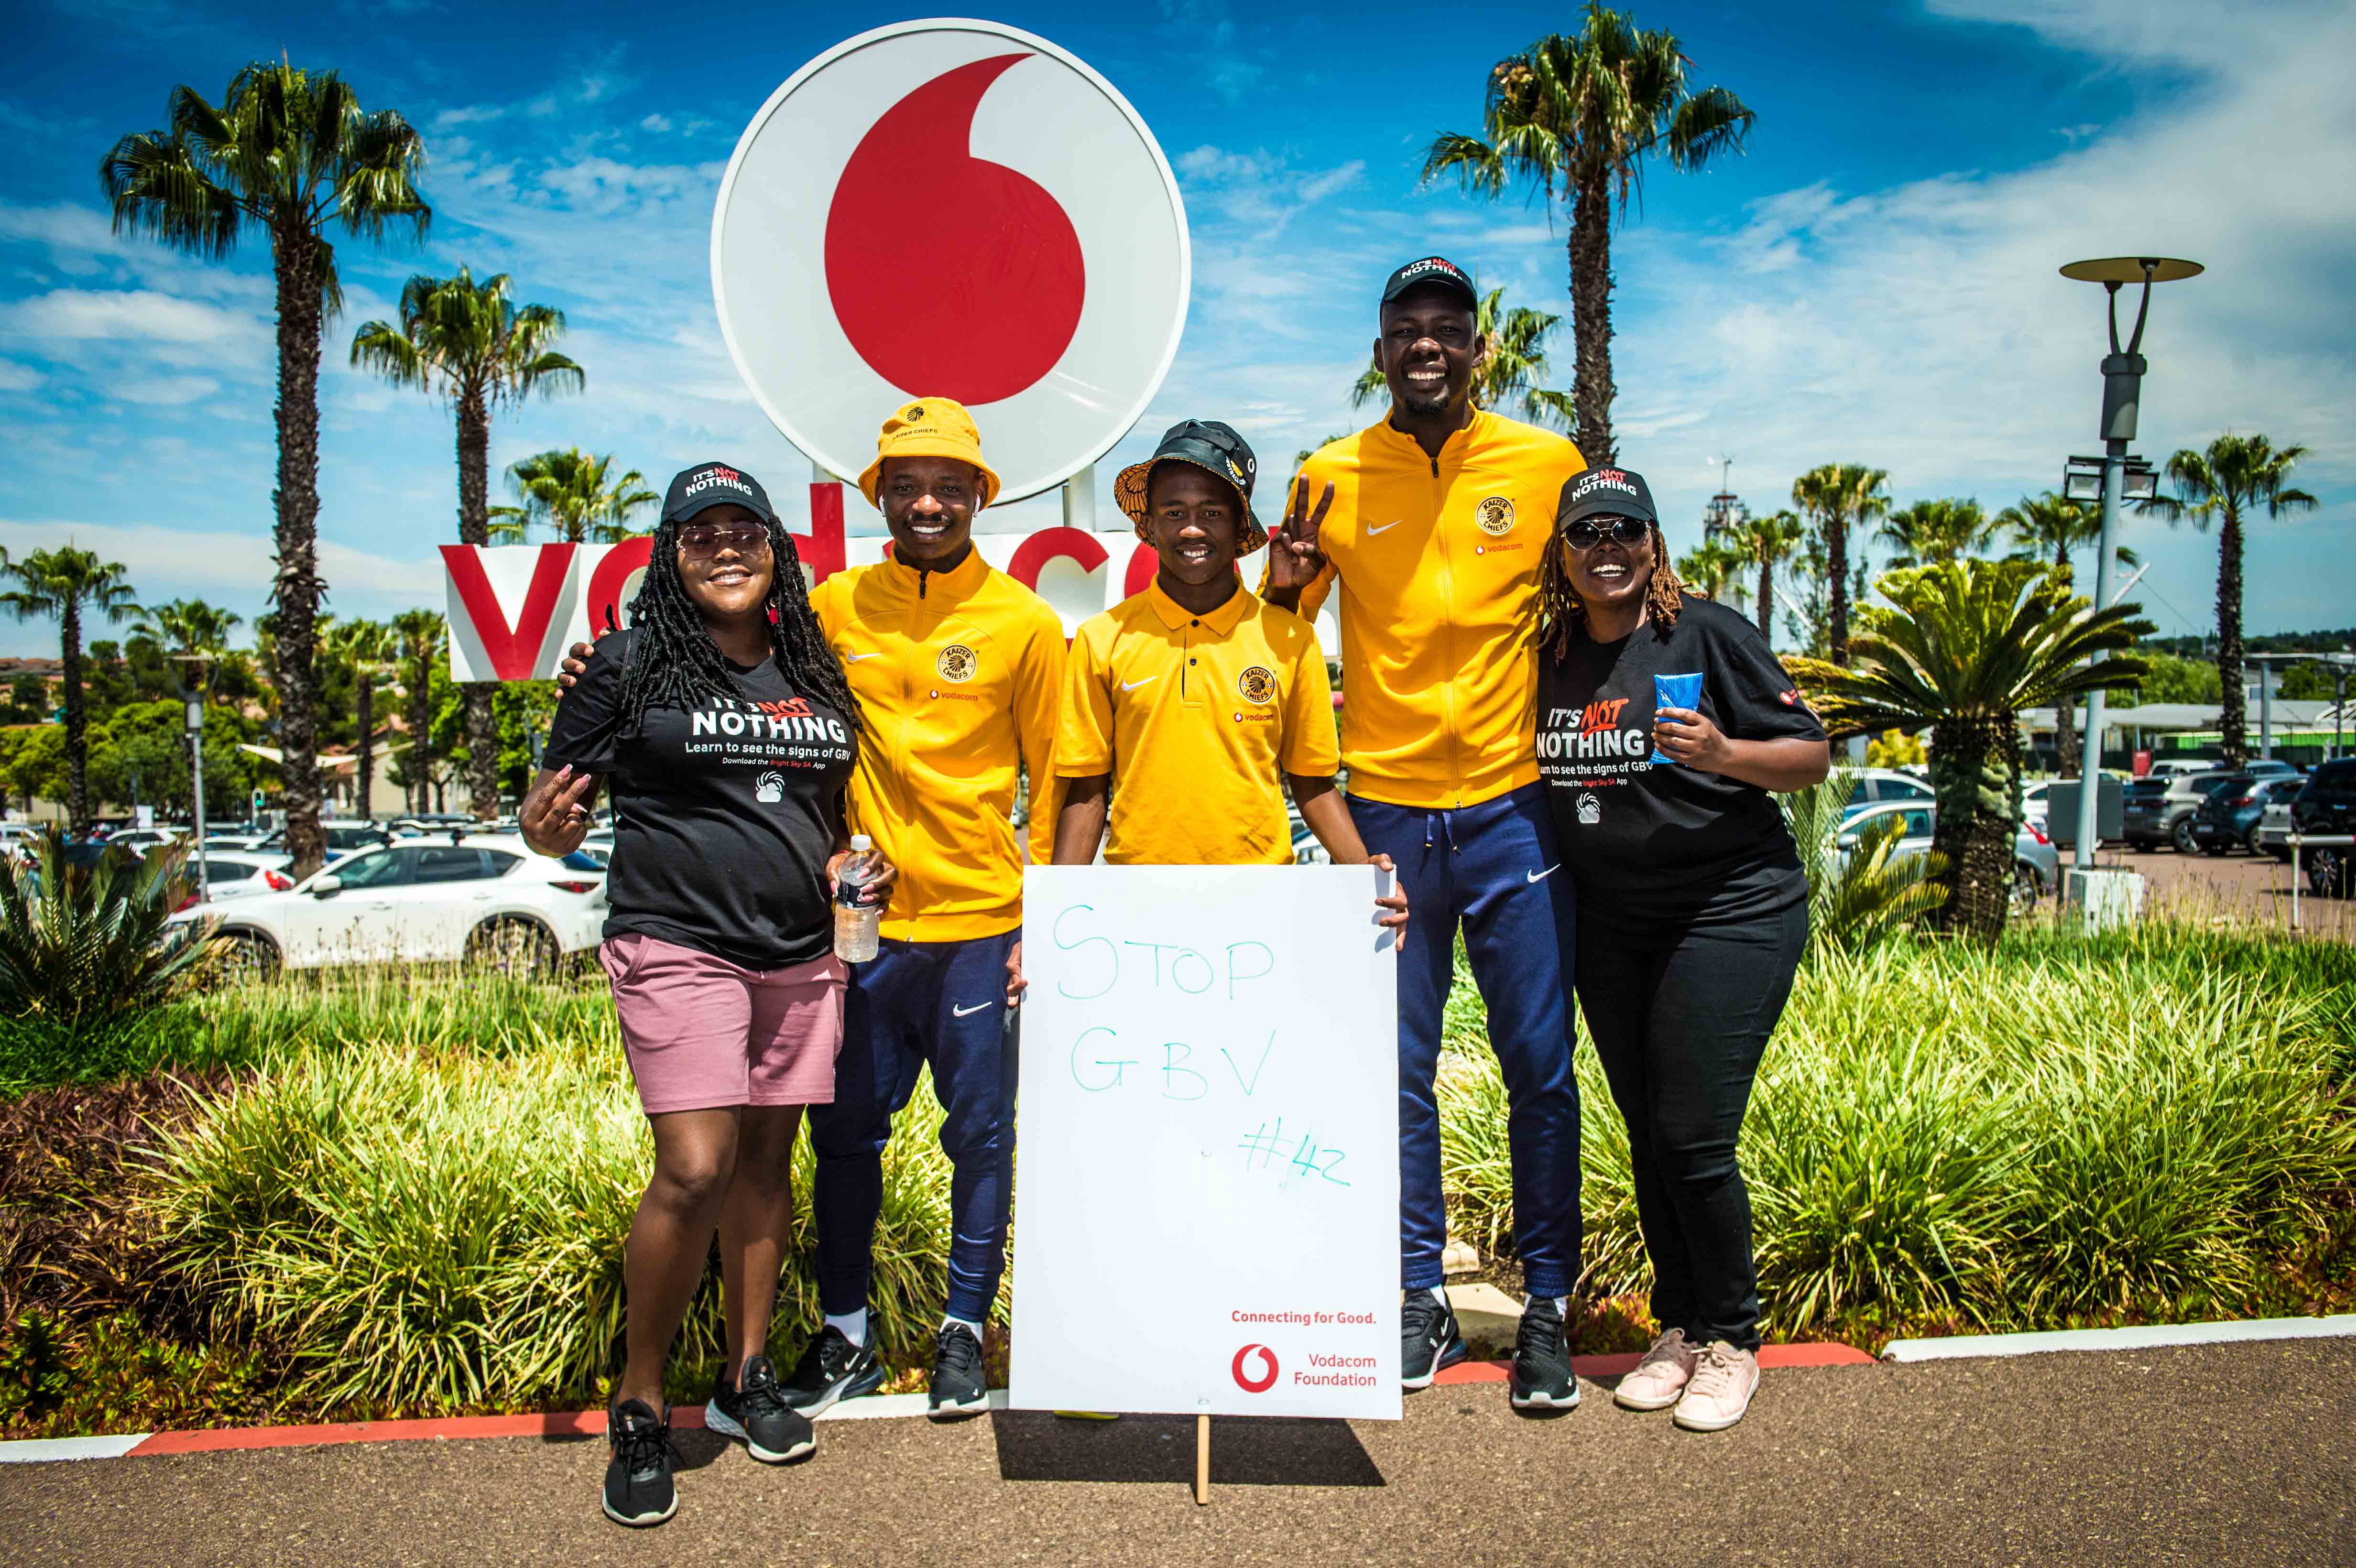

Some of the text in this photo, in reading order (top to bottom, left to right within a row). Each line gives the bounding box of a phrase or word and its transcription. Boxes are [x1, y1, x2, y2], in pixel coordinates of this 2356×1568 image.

[1402, 264, 1463, 280] NOTHIN
[1411, 259, 1456, 271] IT'S NOT
[693, 467, 740, 482] IT'S NOT
[1579, 469, 1626, 487] IT'S NOT
[685, 477, 753, 498] NOTHING
[1572, 479, 1637, 502] NOTHING
[1483, 500, 1507, 511] KAIZER
[1483, 521, 1508, 531] CHIEFS
[1488, 543, 1523, 552] vodacom
[946, 648, 971, 660] KAIZER
[943, 667, 968, 679] CHIEFS
[1246, 669, 1269, 680] KAIZER
[941, 692, 978, 701] vodacom
[1245, 689, 1269, 700] CHIEFS
[757, 697, 814, 718] NOT
[1548, 698, 1629, 731] IT'S NOT
[693, 711, 847, 743] NOTHING
[1536, 729, 1645, 758] NOTHING
[685, 742, 851, 761] Learn to see the signs of GBV
[722, 757, 756, 765] Download
[770, 759, 790, 767] Bright
[791, 760, 802, 768] Sky
[813, 762, 826, 770] App
[1551, 765, 1560, 774] to
[1561, 766, 1576, 774] see
[1577, 765, 1592, 774] the
[1593, 763, 1617, 776] signs
[1619, 762, 1629, 773] of
[1551, 779, 1573, 787] Download
[1583, 780, 1598, 788] Bright
[1616, 777, 1627, 785] App
[1053, 904, 1274, 1001] STOP
[1232, 1310, 1377, 1326] Connecting for Good.
[1309, 1353, 1377, 1368] Vodacom
[1294, 1372, 1377, 1386] Foundation
